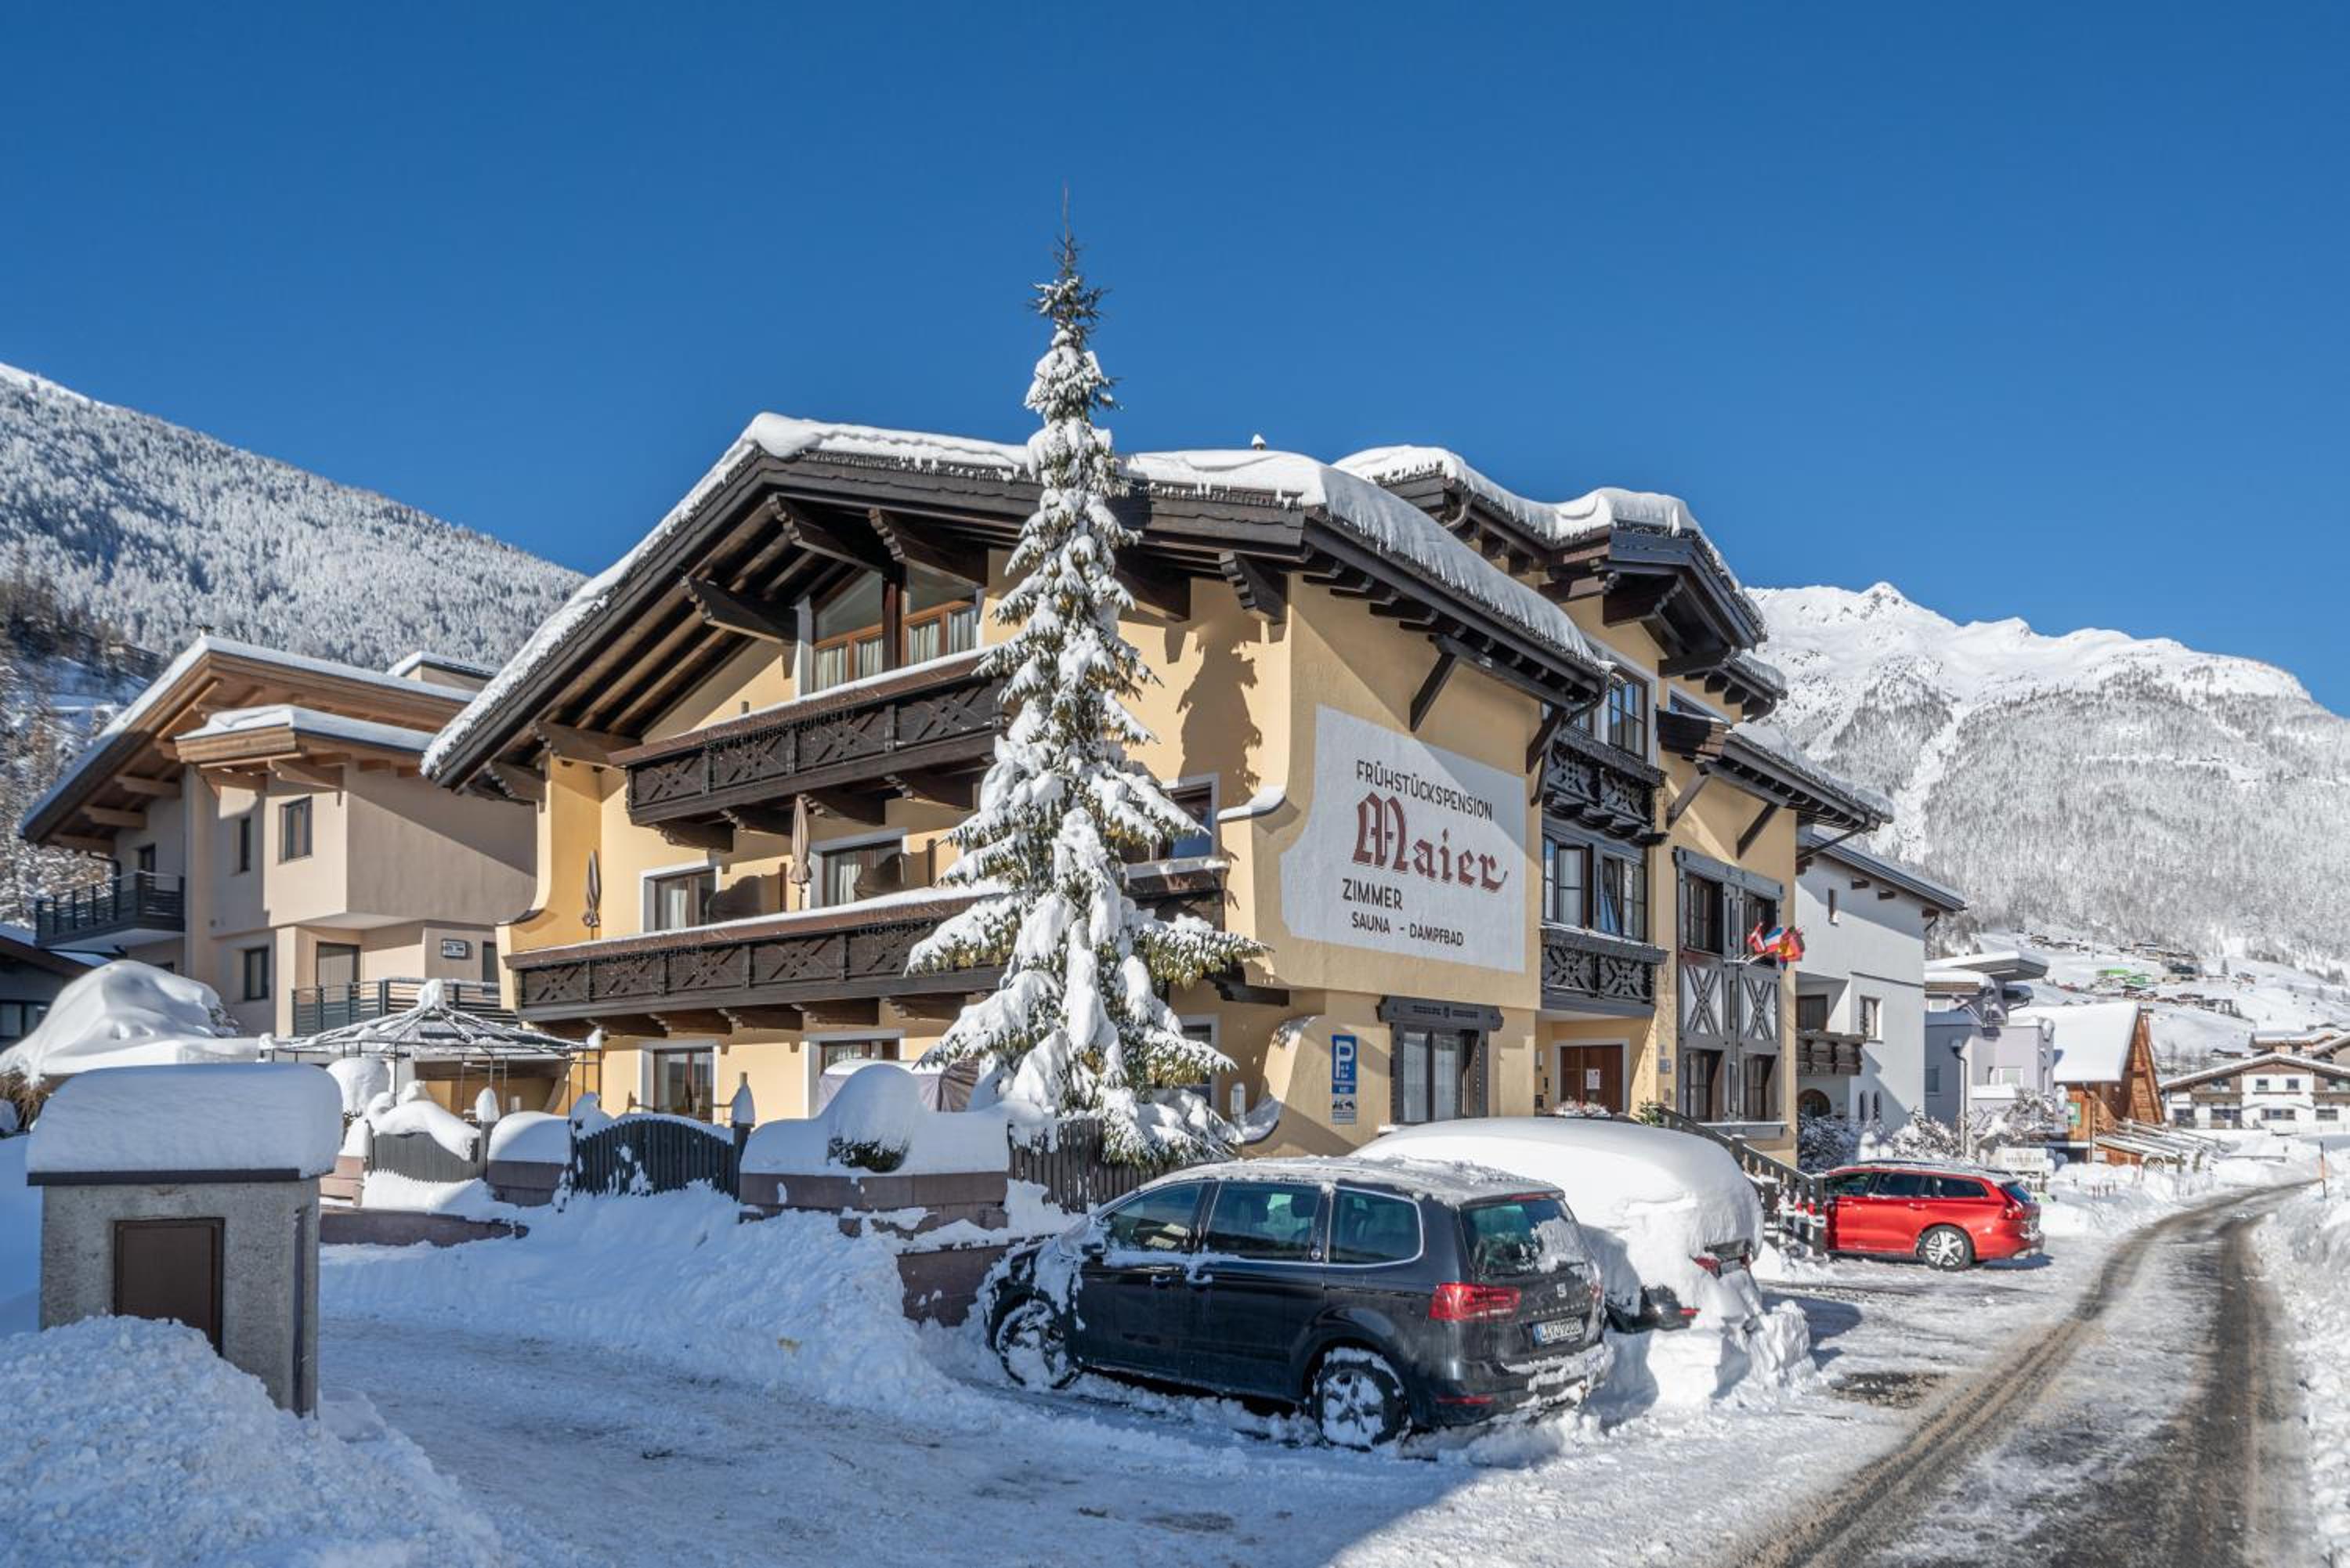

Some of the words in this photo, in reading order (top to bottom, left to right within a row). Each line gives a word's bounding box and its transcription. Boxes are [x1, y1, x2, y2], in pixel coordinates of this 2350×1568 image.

[1357, 759, 1492, 821] FRÜHSTÜCKSPENSION
[1353, 791, 1508, 894] Maier
[1342, 878, 1403, 910] ZIMMER
[1351, 911, 1390, 934] SAUNA
[1409, 923, 1464, 947] DAMPFBAD
[1335, 1040, 1354, 1078] P
